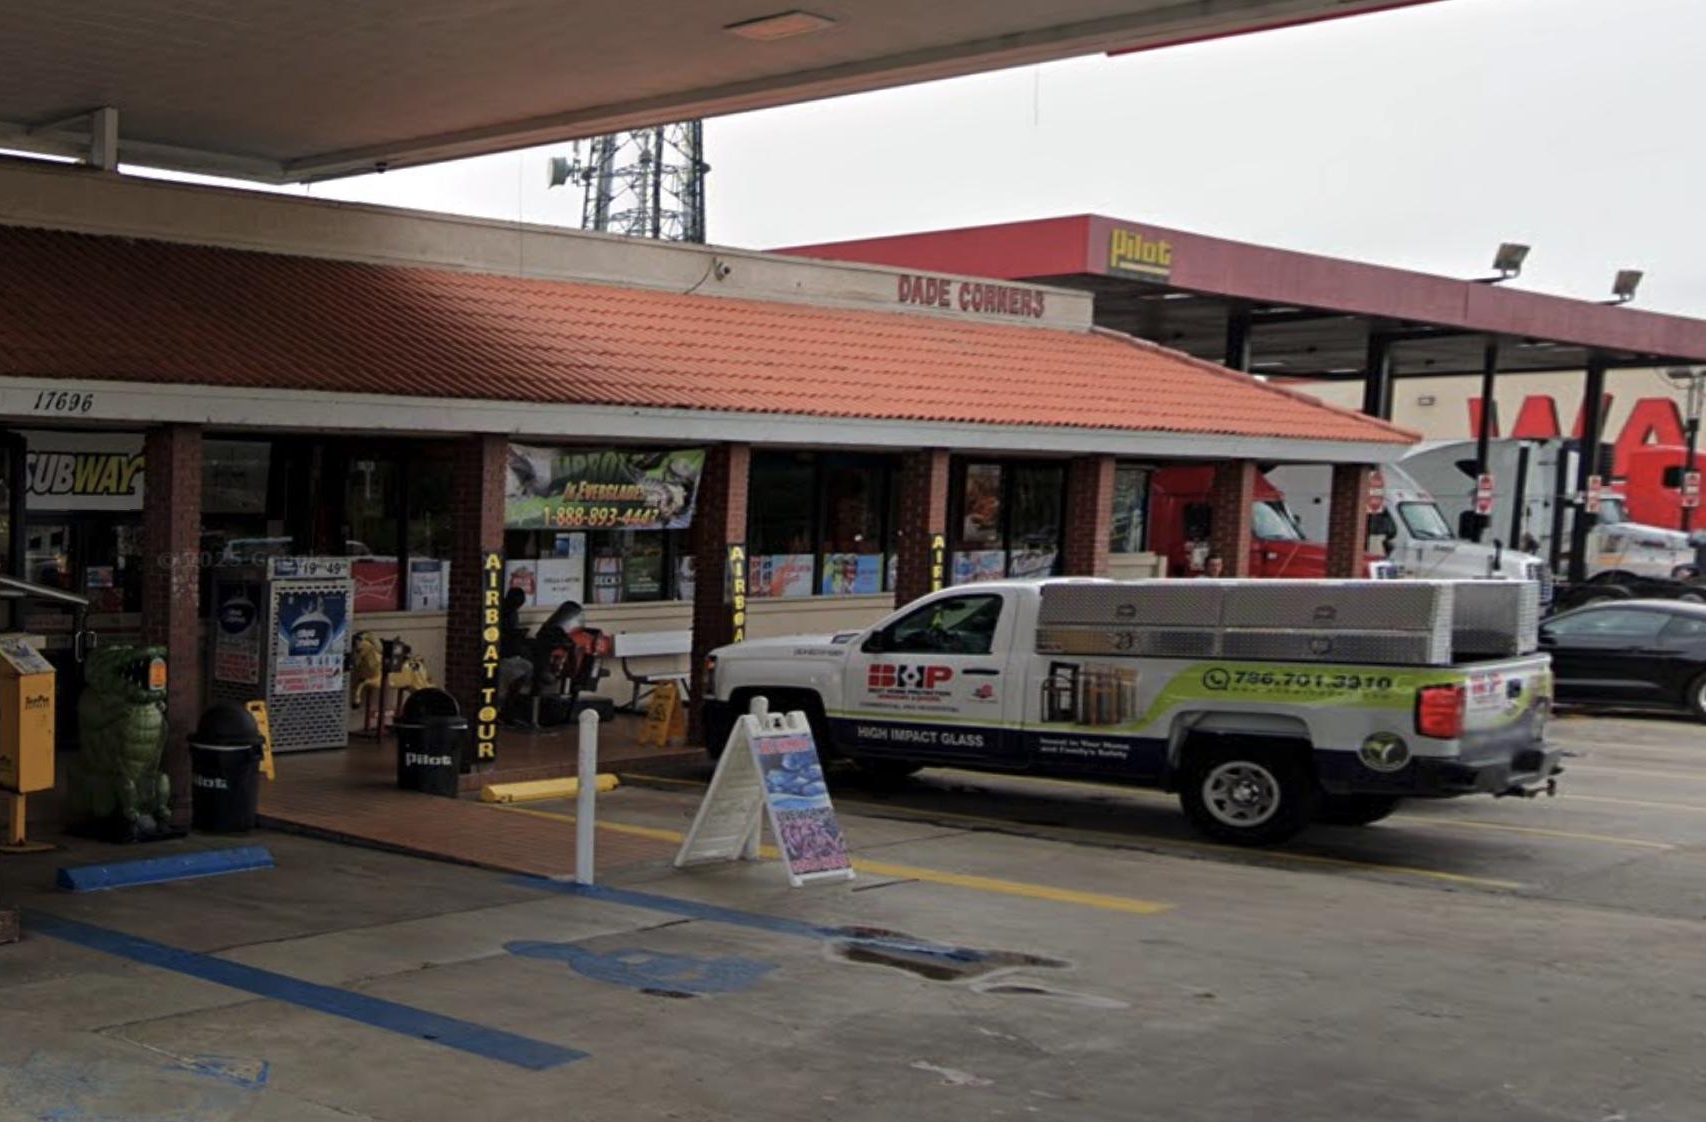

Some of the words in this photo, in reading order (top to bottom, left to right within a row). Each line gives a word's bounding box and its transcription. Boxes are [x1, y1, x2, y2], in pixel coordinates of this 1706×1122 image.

[898, 273, 950, 307] DADE
[958, 282, 1046, 319] CORNERS
[34, 391, 94, 413] 17696
[483, 554, 502, 679] AIRBOAT
[477, 688, 497, 758] TOUR
[857, 725, 888, 740] HIGH
[891, 727, 937, 743] IMPACT
[941, 732, 984, 747] GLASS
